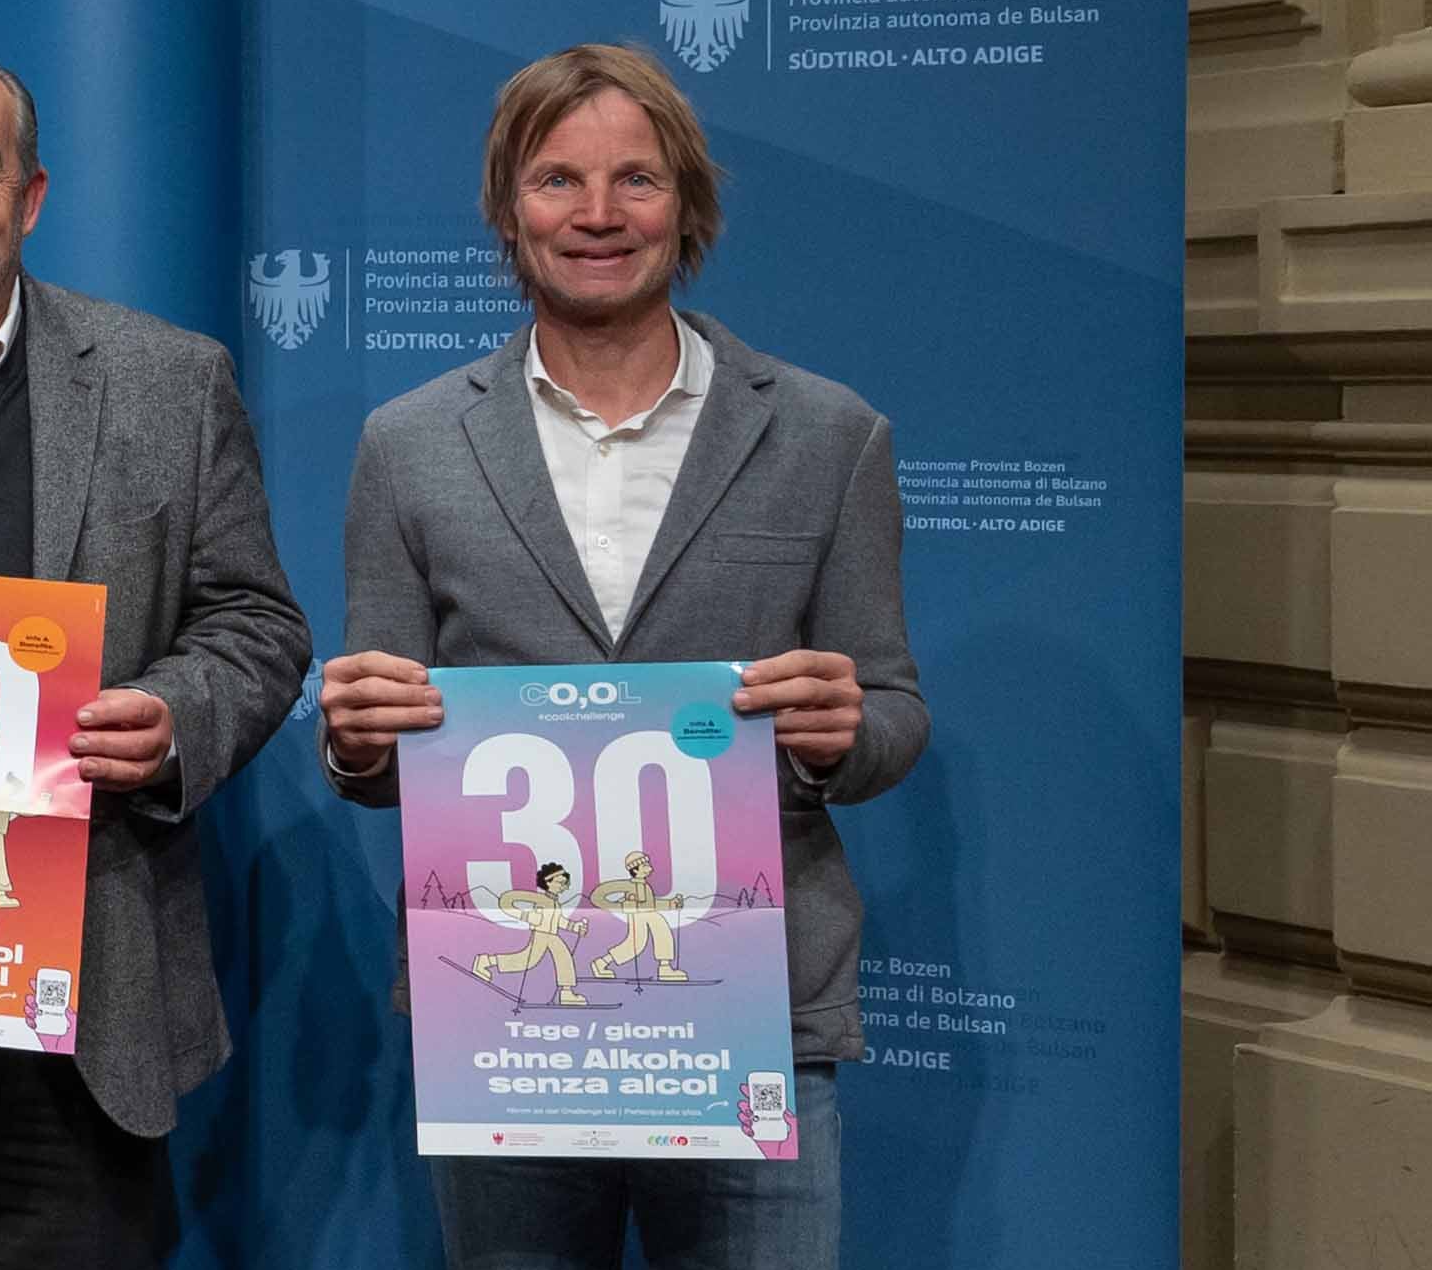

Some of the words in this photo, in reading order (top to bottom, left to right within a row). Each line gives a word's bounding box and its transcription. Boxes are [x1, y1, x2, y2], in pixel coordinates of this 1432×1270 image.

[790, 13, 879, 31] Provinzia
[887, 12, 990, 28] autonoma
[998, 7, 1022, 25] de
[1030, 5, 1099, 23] Bulsan
[789, 50, 897, 69] SÜDTIROL
[912, 48, 966, 65] ALTO
[974, 46, 1043, 64] ADIGE
[365, 248, 459, 263] Autonome
[366, 272, 448, 288] Provincia
[366, 298, 448, 313] Provinzia
[366, 330, 465, 350] SÜDTIROL
[898, 460, 966, 471] Autonome
[971, 461, 1020, 472] Provinz
[1025, 461, 1065, 472] Bozen
[898, 476, 958, 488] Provincia
[963, 479, 1031, 489] autonoma
[1036, 477, 1047, 489] di
[1052, 478, 1107, 490] Bolzano
[963, 495, 1031, 506] autonoma
[1036, 495, 1052, 506] de
[1056, 495, 1101, 506] Bulsan
[980, 519, 1015, 530] ALTO
[1020, 519, 1065, 532] ADIGE
[462, 731, 717, 930] 30
[890, 958, 950, 978] Bozen
[932, 987, 1015, 1008] Bolzano
[505, 1022, 579, 1040] Tage
[605, 1023, 693, 1041] giorni
[938, 1014, 1005, 1035] Bulsan
[474, 1048, 572, 1069] ohne
[583, 1049, 729, 1070] Alkohol
[882, 1048, 950, 1070] ADIGE
[489, 1077, 608, 1093] senza
[619, 1074, 716, 1095] alcol
